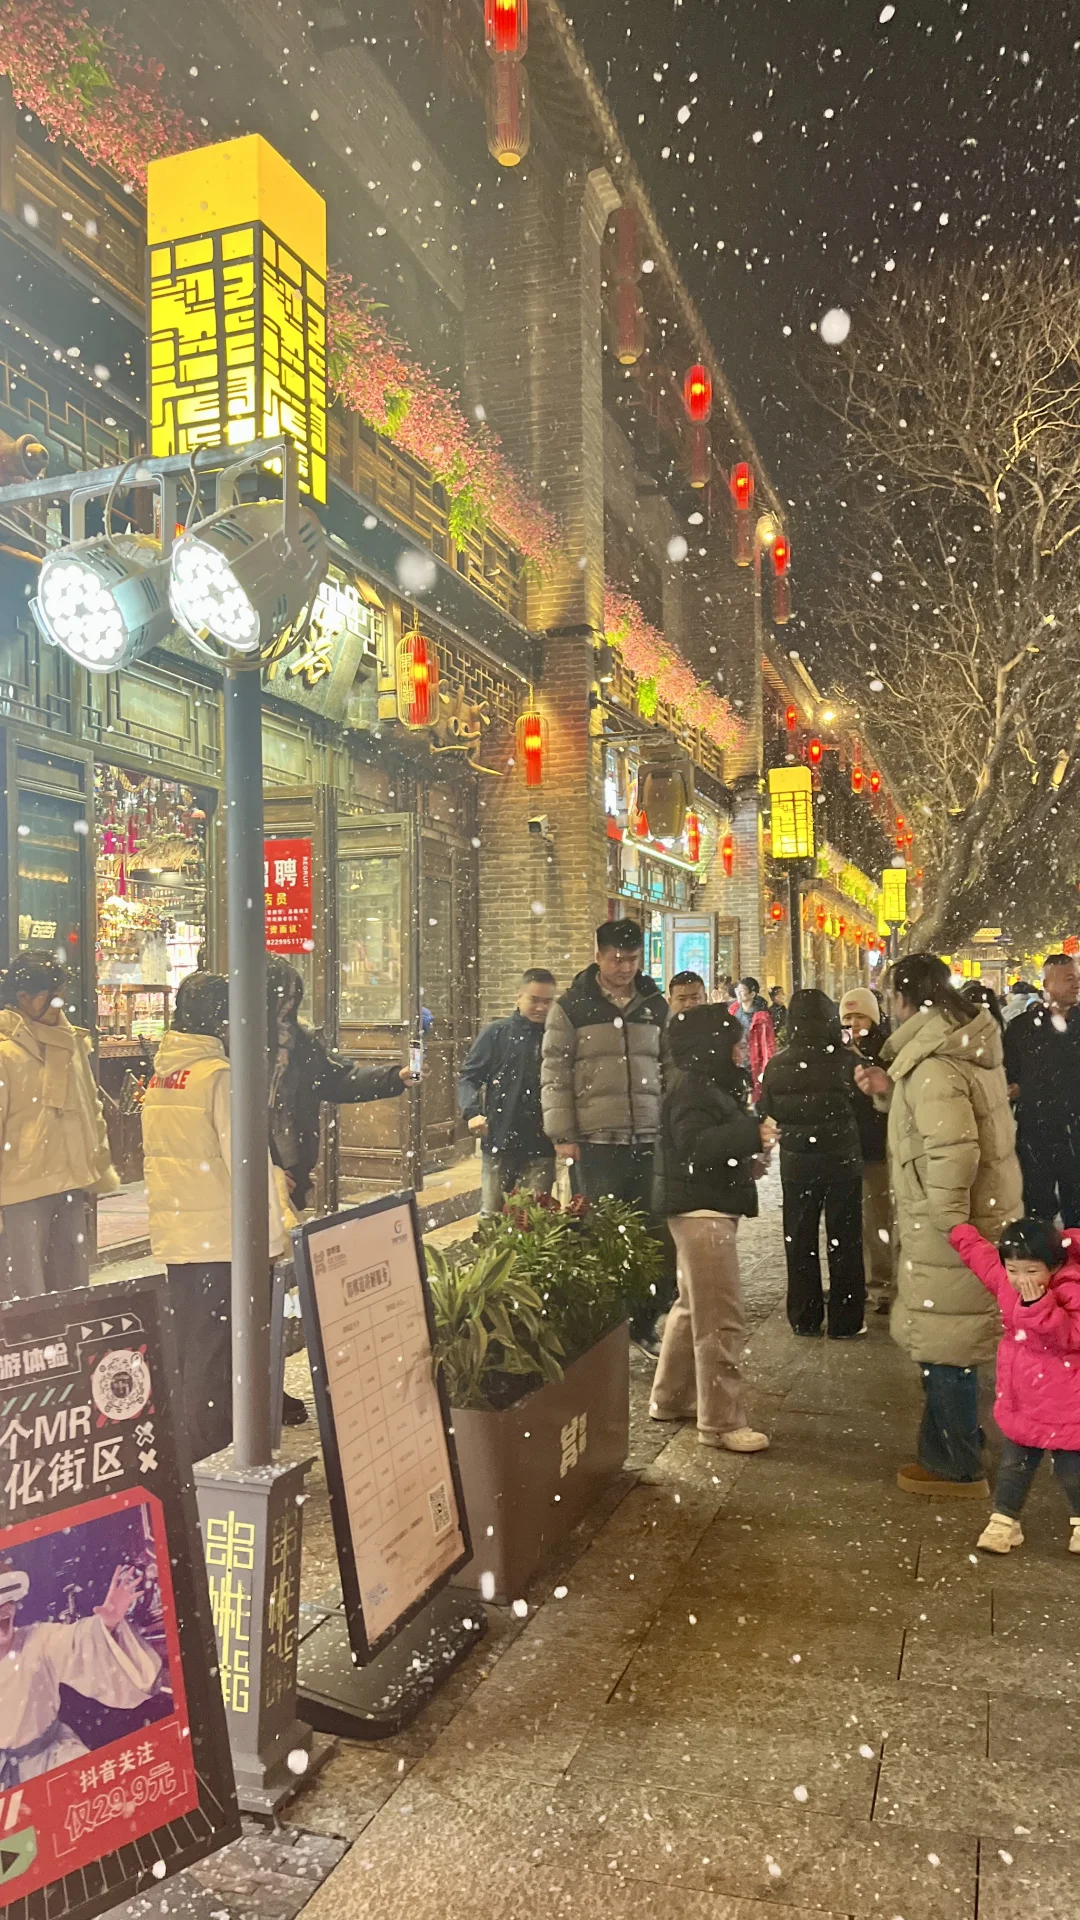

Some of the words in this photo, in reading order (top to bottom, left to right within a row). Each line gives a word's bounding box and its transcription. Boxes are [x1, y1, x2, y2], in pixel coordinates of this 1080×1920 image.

[4, 1436, 124, 1510] 化街区
[79, 1741, 155, 1794] 抖音关注
